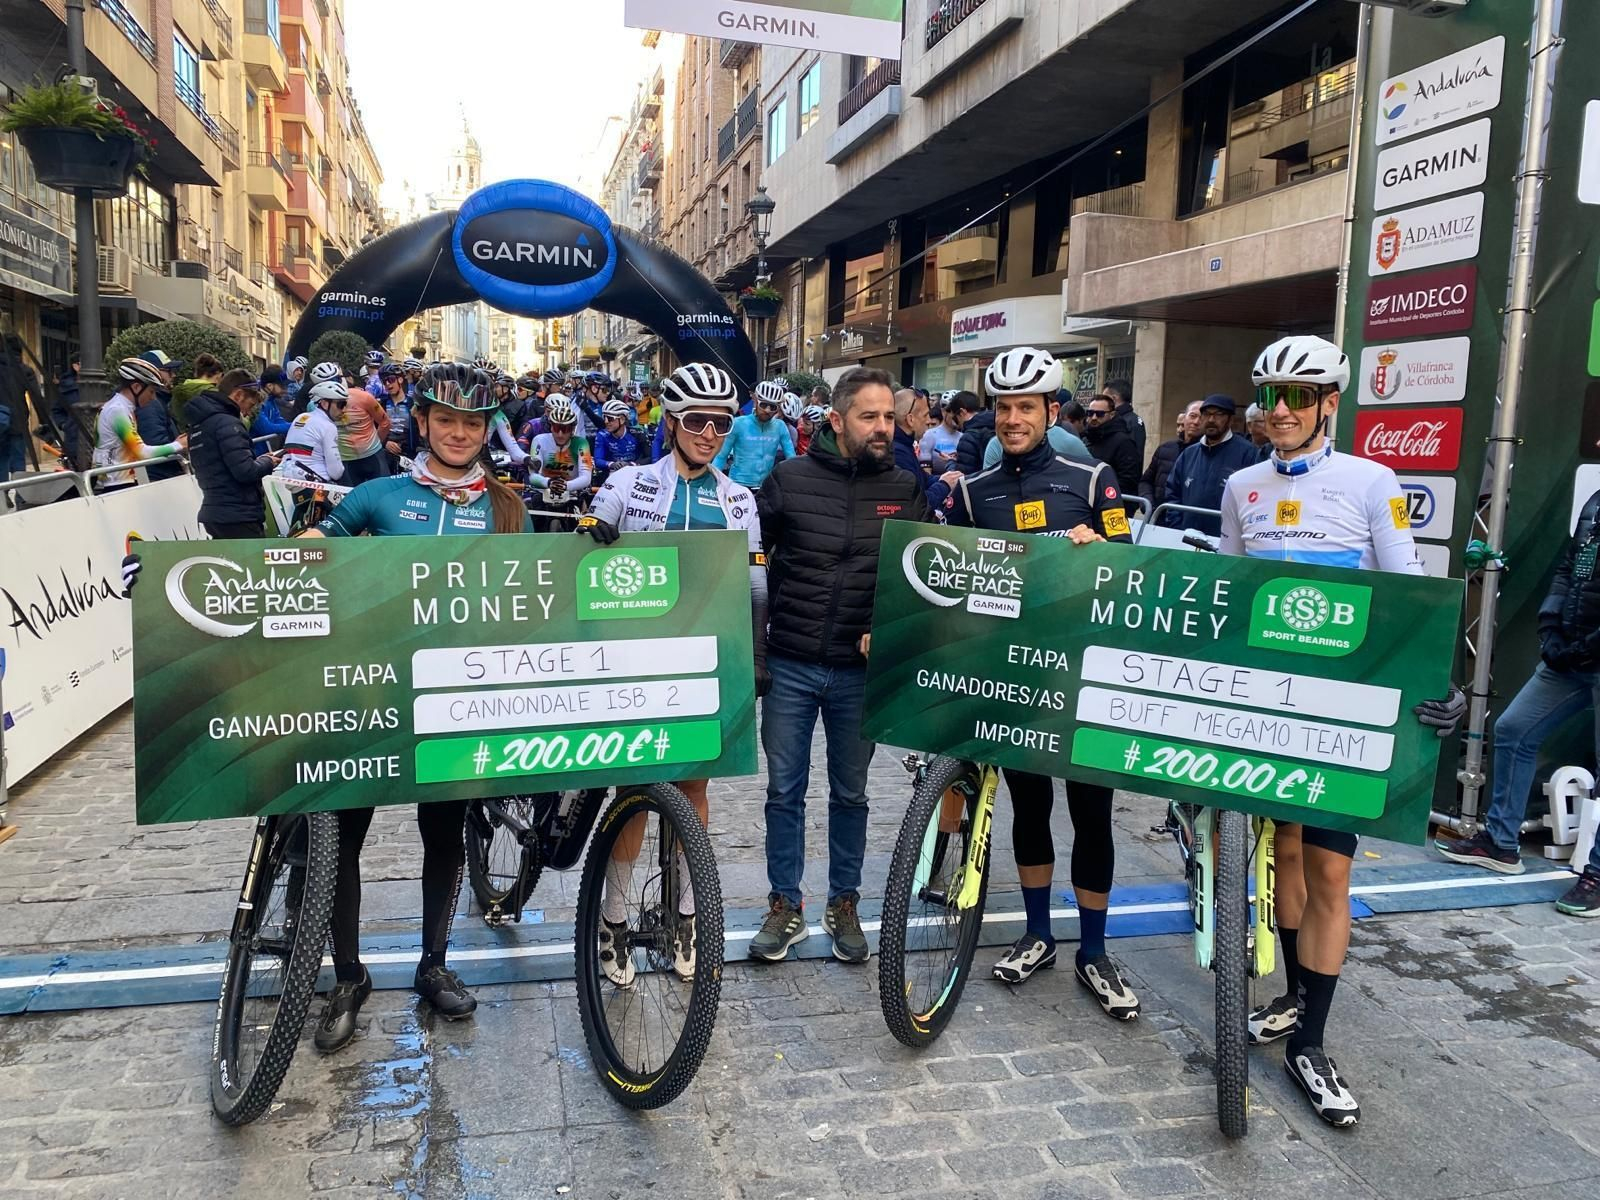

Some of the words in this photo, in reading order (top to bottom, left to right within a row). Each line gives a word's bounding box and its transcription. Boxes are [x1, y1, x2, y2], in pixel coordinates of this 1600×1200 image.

[718, 11, 815, 38] GARMIN
[1414, 56, 1493, 103] Andalucía
[1383, 144, 1477, 187] GARMIN
[1403, 216, 1474, 245] ADAMUZ
[39, 239, 59, 262] JESÚS
[472, 240, 593, 269] GARMIN
[321, 291, 386, 306] garmin.es
[1391, 284, 1467, 313] IMDECO
[318, 306, 384, 322] garmin.pt
[677, 312, 733, 326] garmin.es
[953, 312, 1007, 335] FLOWERING
[1389, 315, 1412, 324] Municipal
[1419, 311, 1442, 320] Deportes
[679, 326, 736, 339] garmin.pt
[1407, 362, 1453, 373] Villafranca
[1405, 377, 1415, 387] de
[1417, 375, 1455, 386] Córdoba
[633, 481, 659, 496] 226ERS
[457, 520, 484, 528] GARMIN
[1021, 506, 1039, 521] Buff
[982, 541, 1003, 551] UCI
[1007, 543, 1024, 553] SHC
[1252, 530, 1327, 541] megamo
[271, 551, 297, 562] UCI
[303, 551, 323, 561] SHC
[929, 547, 1023, 580] Andalucía
[203, 565, 329, 596] Andalucía
[411, 560, 553, 589] PRIZE
[927, 570, 968, 590] BIKE
[971, 575, 1023, 598] RACE
[1094, 566, 1231, 606] PRIZE
[0, 556, 123, 648] Andalucía
[205, 594, 258, 616] BIKE
[265, 592, 329, 613] RACE
[413, 594, 555, 625] MONEY
[590, 601, 619, 610] SPORT
[622, 599, 668, 609] BEARINGS
[973, 600, 1015, 612] GARMIN
[270, 621, 323, 631] GARMIN
[1090, 599, 1229, 639] MONEY
[1262, 630, 1296, 642] SPORT
[1297, 634, 1350, 648] BEARINGS
[464, 647, 574, 680] STAGE
[590, 646, 611, 672] 1
[1008, 645, 1069, 671] ETAPA
[323, 663, 398, 688] ETAPA
[1123, 654, 1251, 698] STAGE
[1276, 677, 1296, 707] 1
[917, 669, 1065, 710] GANADORES/AS
[450, 691, 590, 722] CANNONDALE
[607, 687, 647, 710] ISB
[667, 686, 680, 707] 2
[208, 707, 399, 740] GANADORES/AS
[1109, 697, 1177, 727] BUFF
[1194, 711, 1291, 746] MEGAMO
[1301, 726, 1366, 761] TEAM
[975, 721, 1061, 753] IMPORTE
[296, 756, 401, 784] IMPORTE
[609, 796, 643, 822] SCORPION
